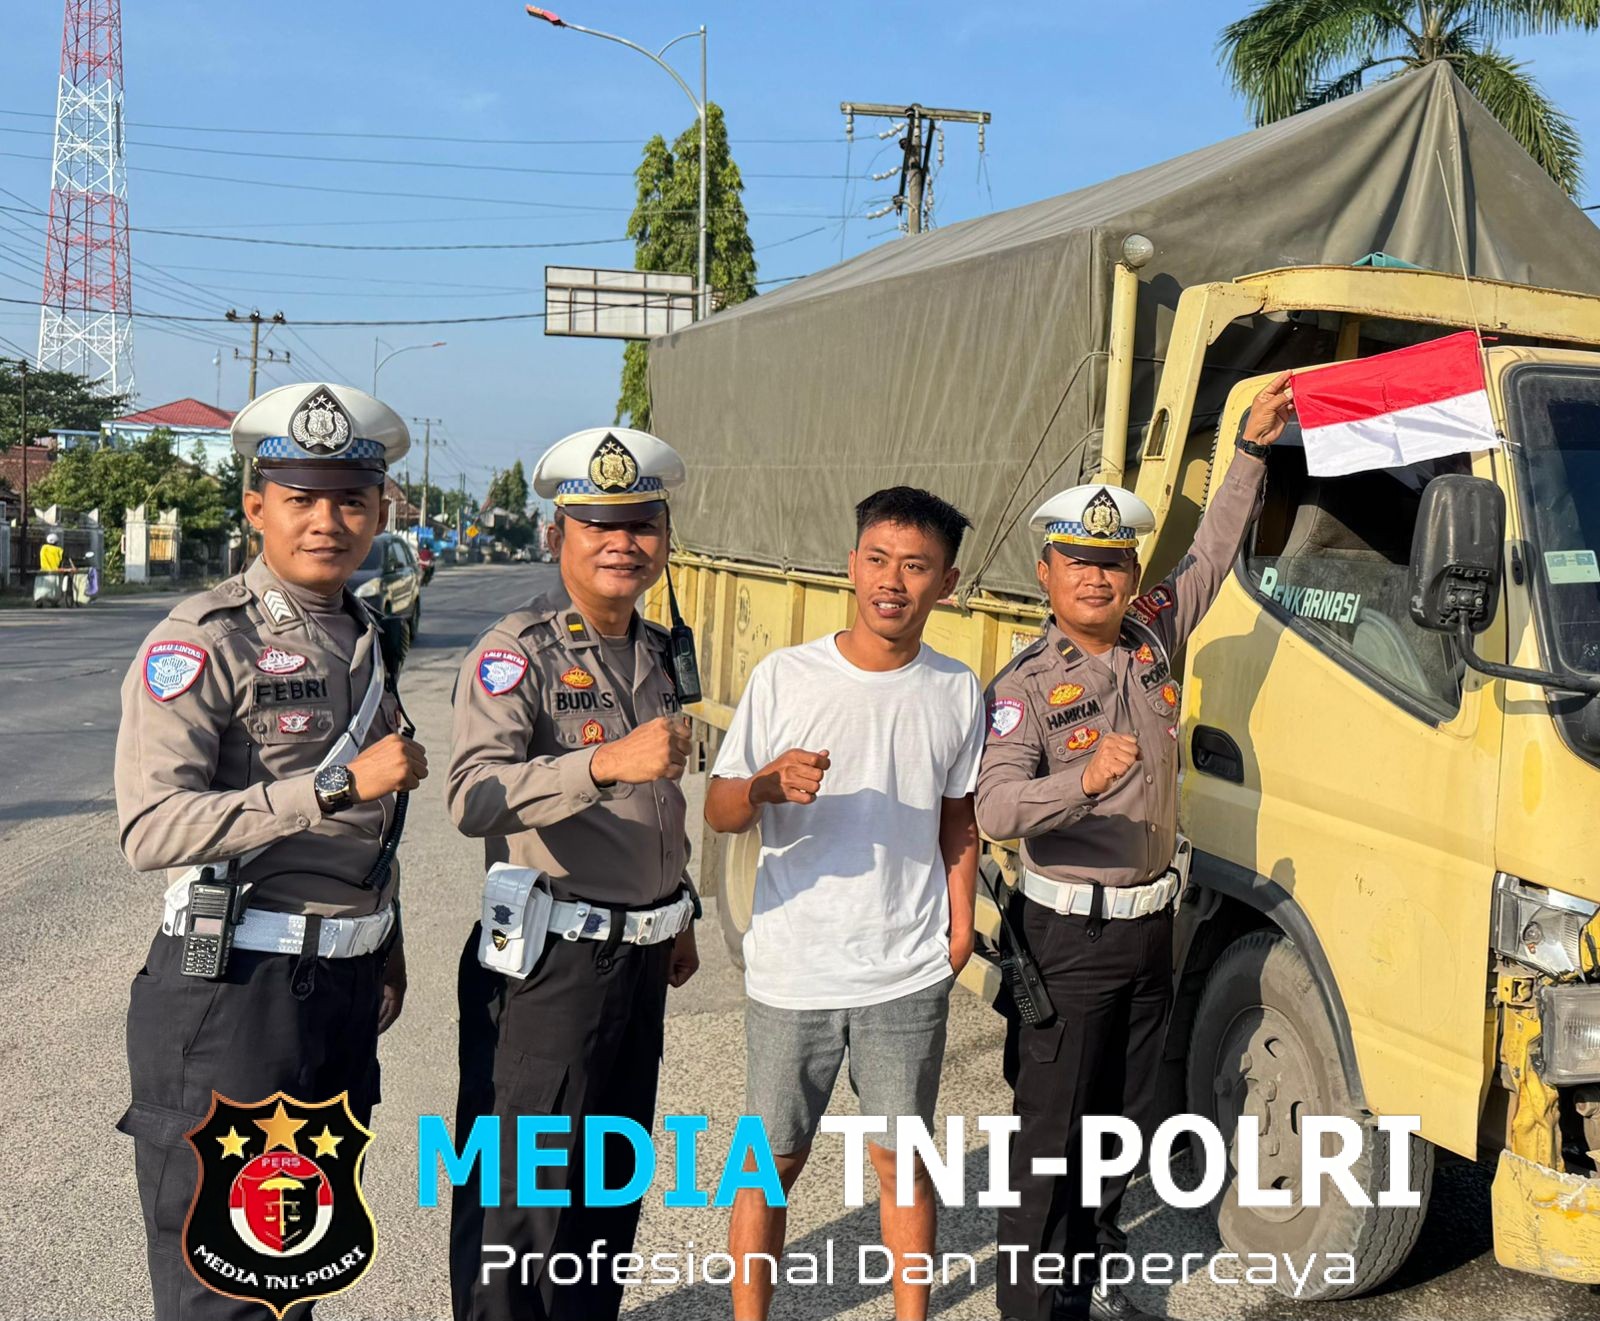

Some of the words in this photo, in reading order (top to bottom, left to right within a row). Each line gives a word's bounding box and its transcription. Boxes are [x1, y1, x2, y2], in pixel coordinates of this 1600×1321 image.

[256, 678, 328, 704] FEBRI
[556, 692, 600, 711] BUDI
[601, 692, 615, 709] S
